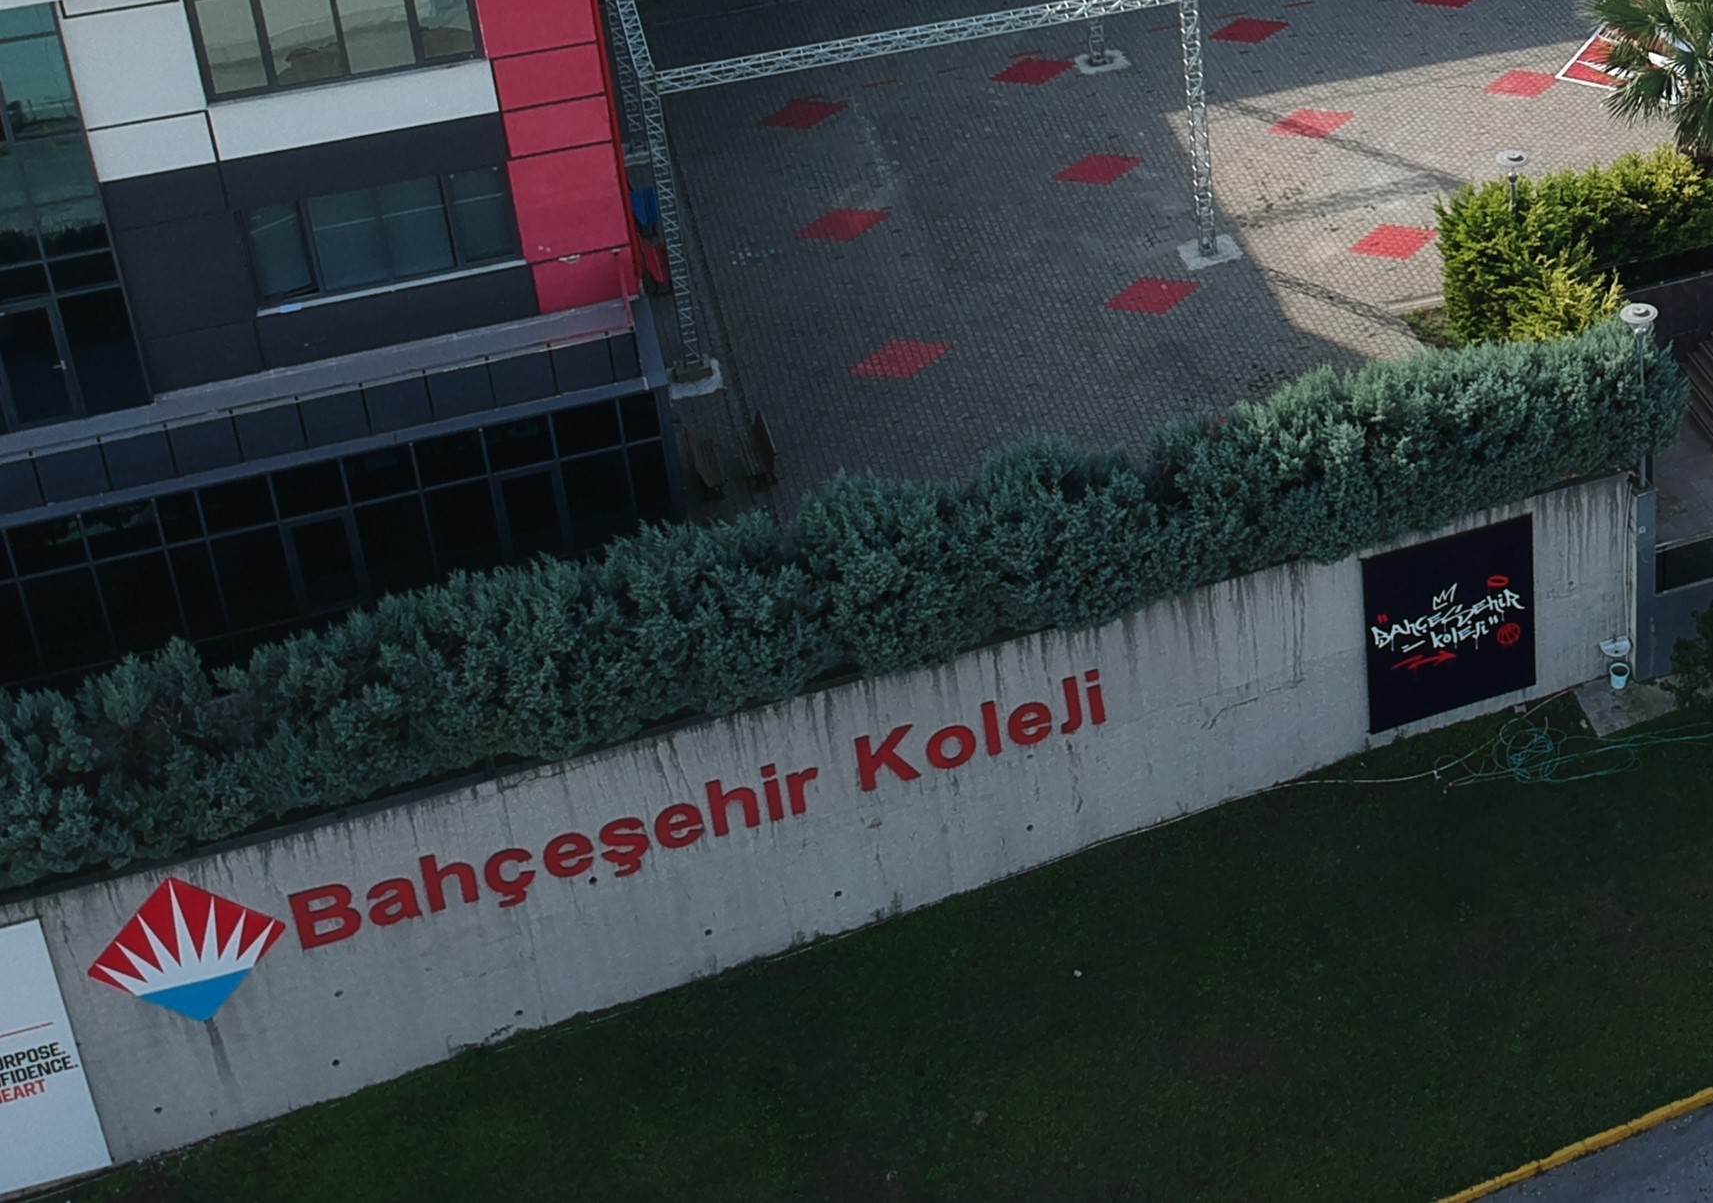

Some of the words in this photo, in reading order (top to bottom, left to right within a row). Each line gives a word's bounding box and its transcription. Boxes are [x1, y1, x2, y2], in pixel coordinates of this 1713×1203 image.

[287, 763, 819, 950] Bahçeşehir
[0, 1055, 79, 1087] FIDENCE.
[0, 1078, 46, 1104] EART
